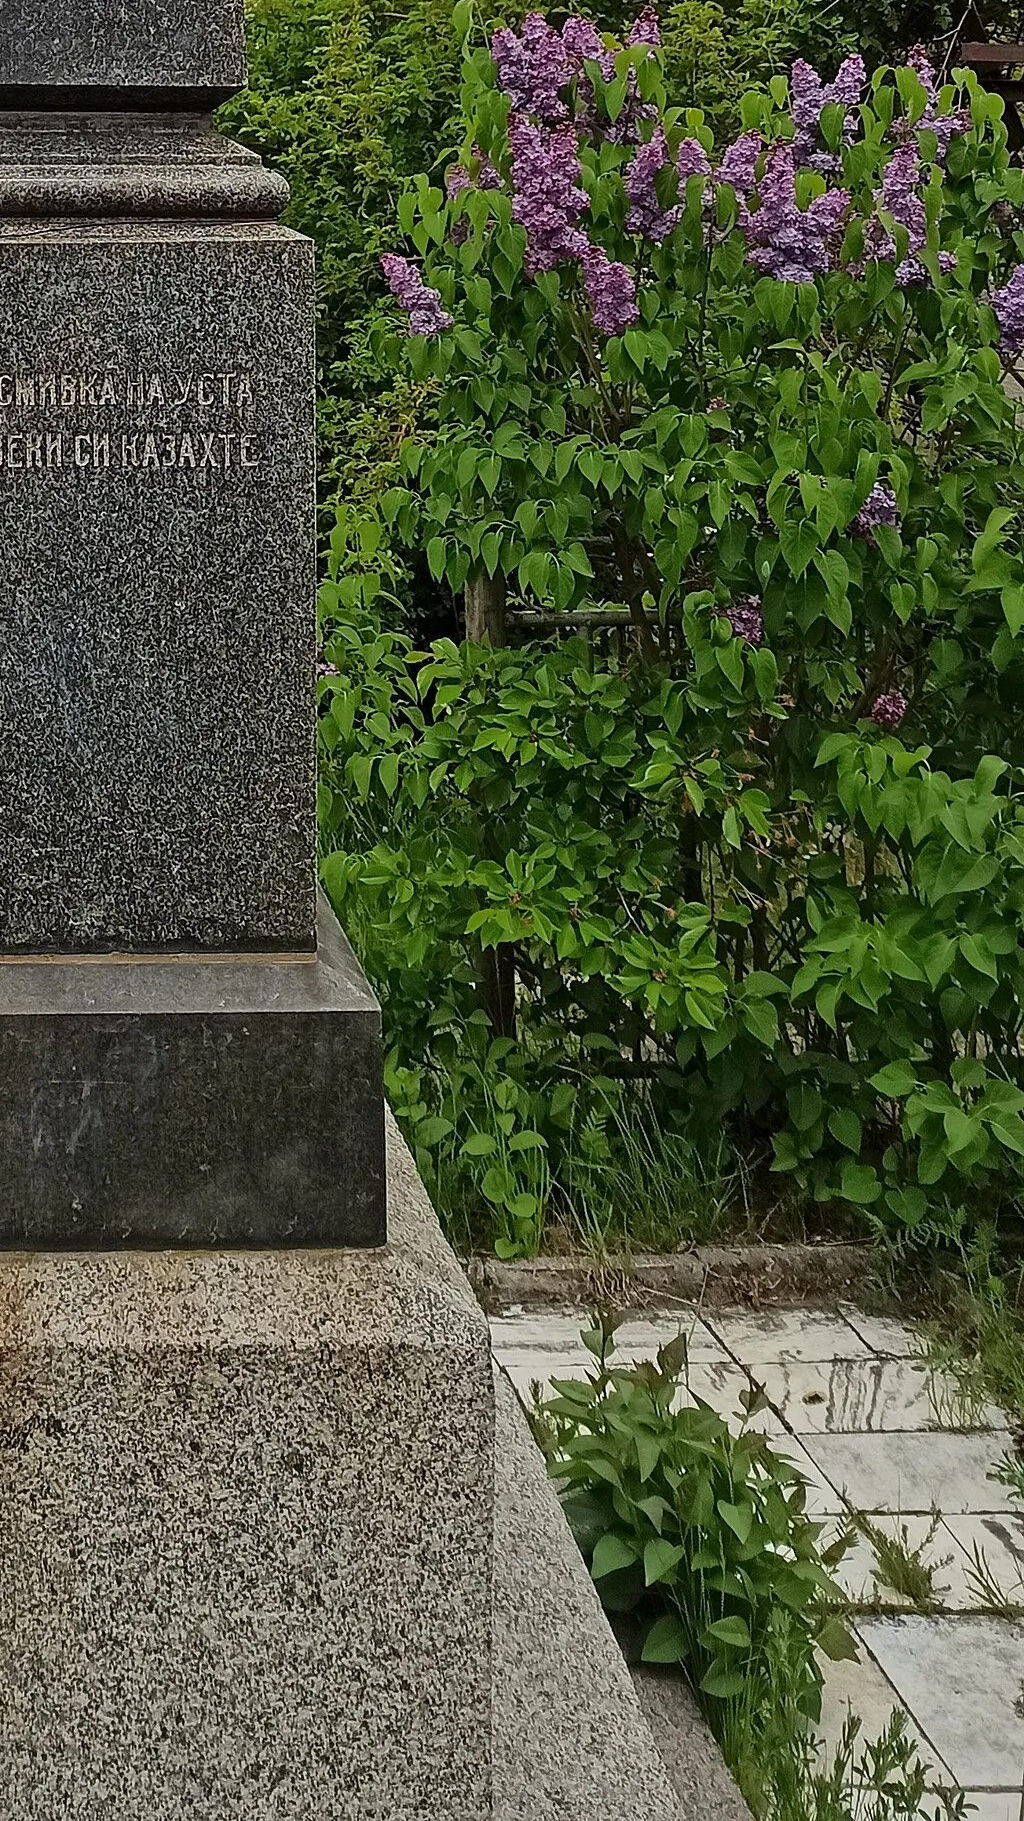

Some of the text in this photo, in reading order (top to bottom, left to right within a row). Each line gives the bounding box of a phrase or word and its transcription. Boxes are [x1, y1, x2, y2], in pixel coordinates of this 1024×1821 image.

[128, 373, 165, 406] НА
[176, 372, 254, 407] УСТА
[74, 432, 110, 467] СИ
[121, 431, 259, 467] КАЗАХТЕ
